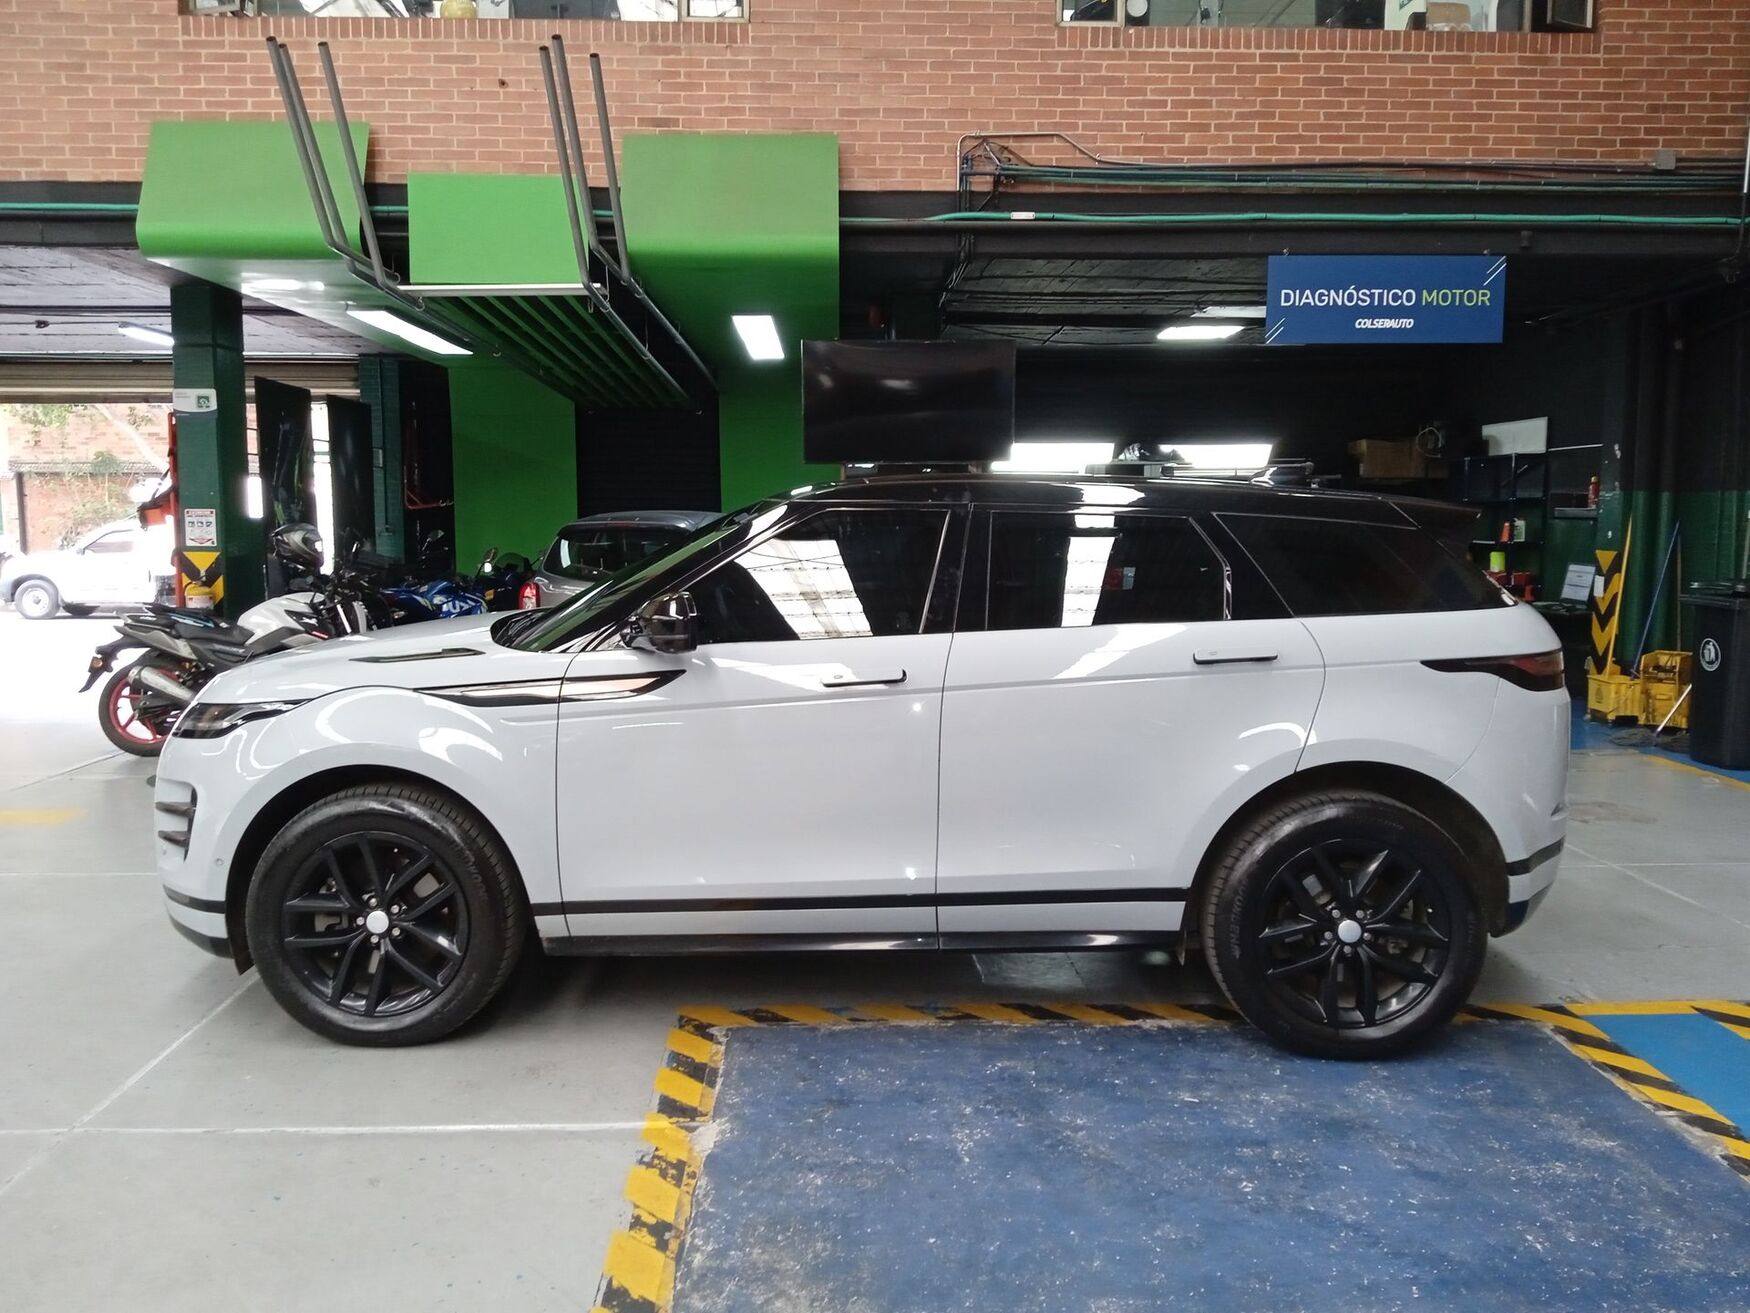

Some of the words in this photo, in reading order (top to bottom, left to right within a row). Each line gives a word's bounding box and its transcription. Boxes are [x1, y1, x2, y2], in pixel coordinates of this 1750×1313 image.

[1280, 285, 1416, 307] DIAGNÓSTICO
[1422, 288, 1491, 306] MOTOR
[1354, 318, 1415, 329] COLSERAUTO
